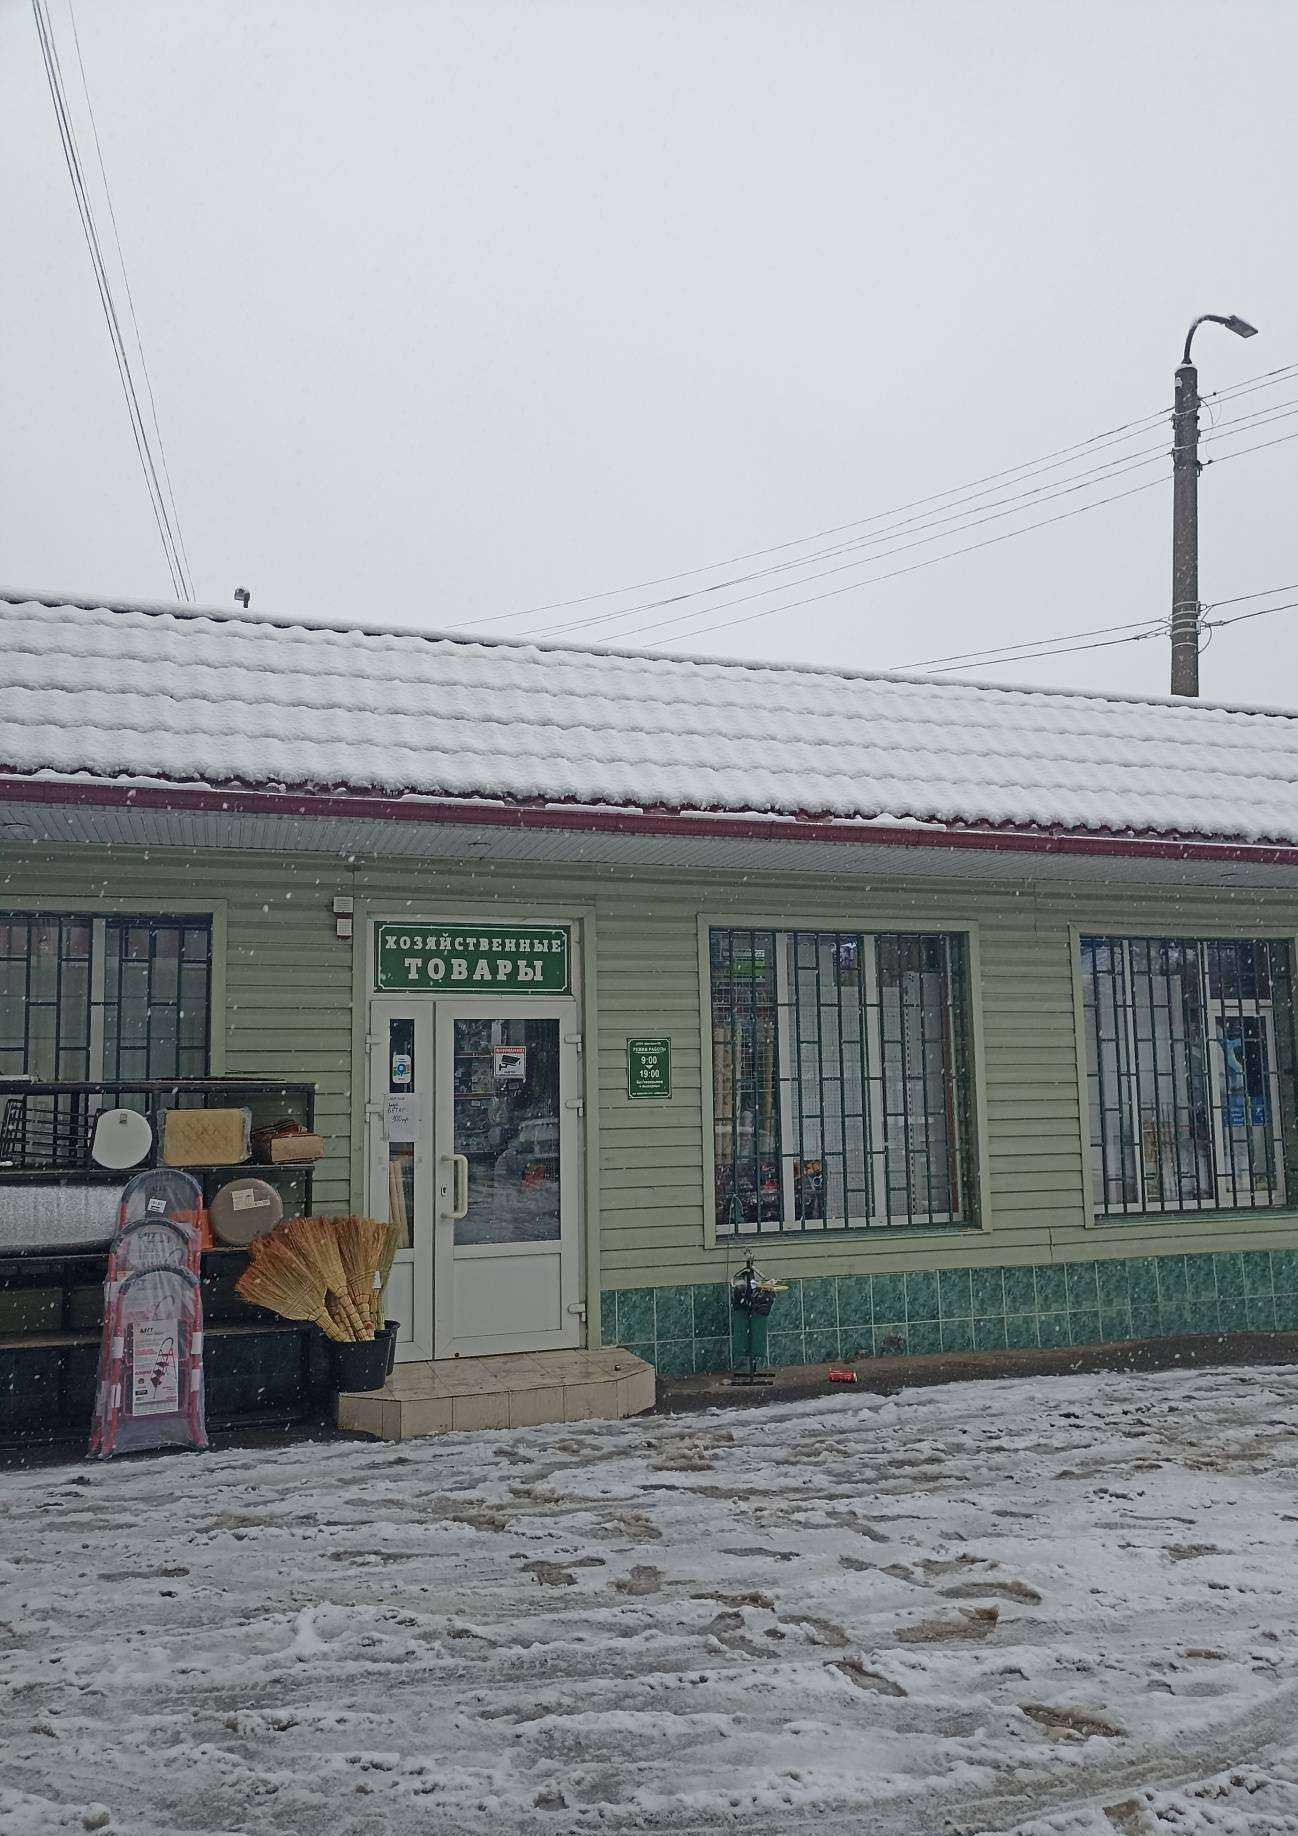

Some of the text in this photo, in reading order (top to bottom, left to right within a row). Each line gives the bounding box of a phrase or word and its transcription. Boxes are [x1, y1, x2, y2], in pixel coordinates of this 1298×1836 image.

[385, 933, 561, 953] ХОЗЯЙСТВЕННЫЕ
[404, 957, 544, 981] ТОВАРЫ
[639, 1069, 660, 1078] 19:00
